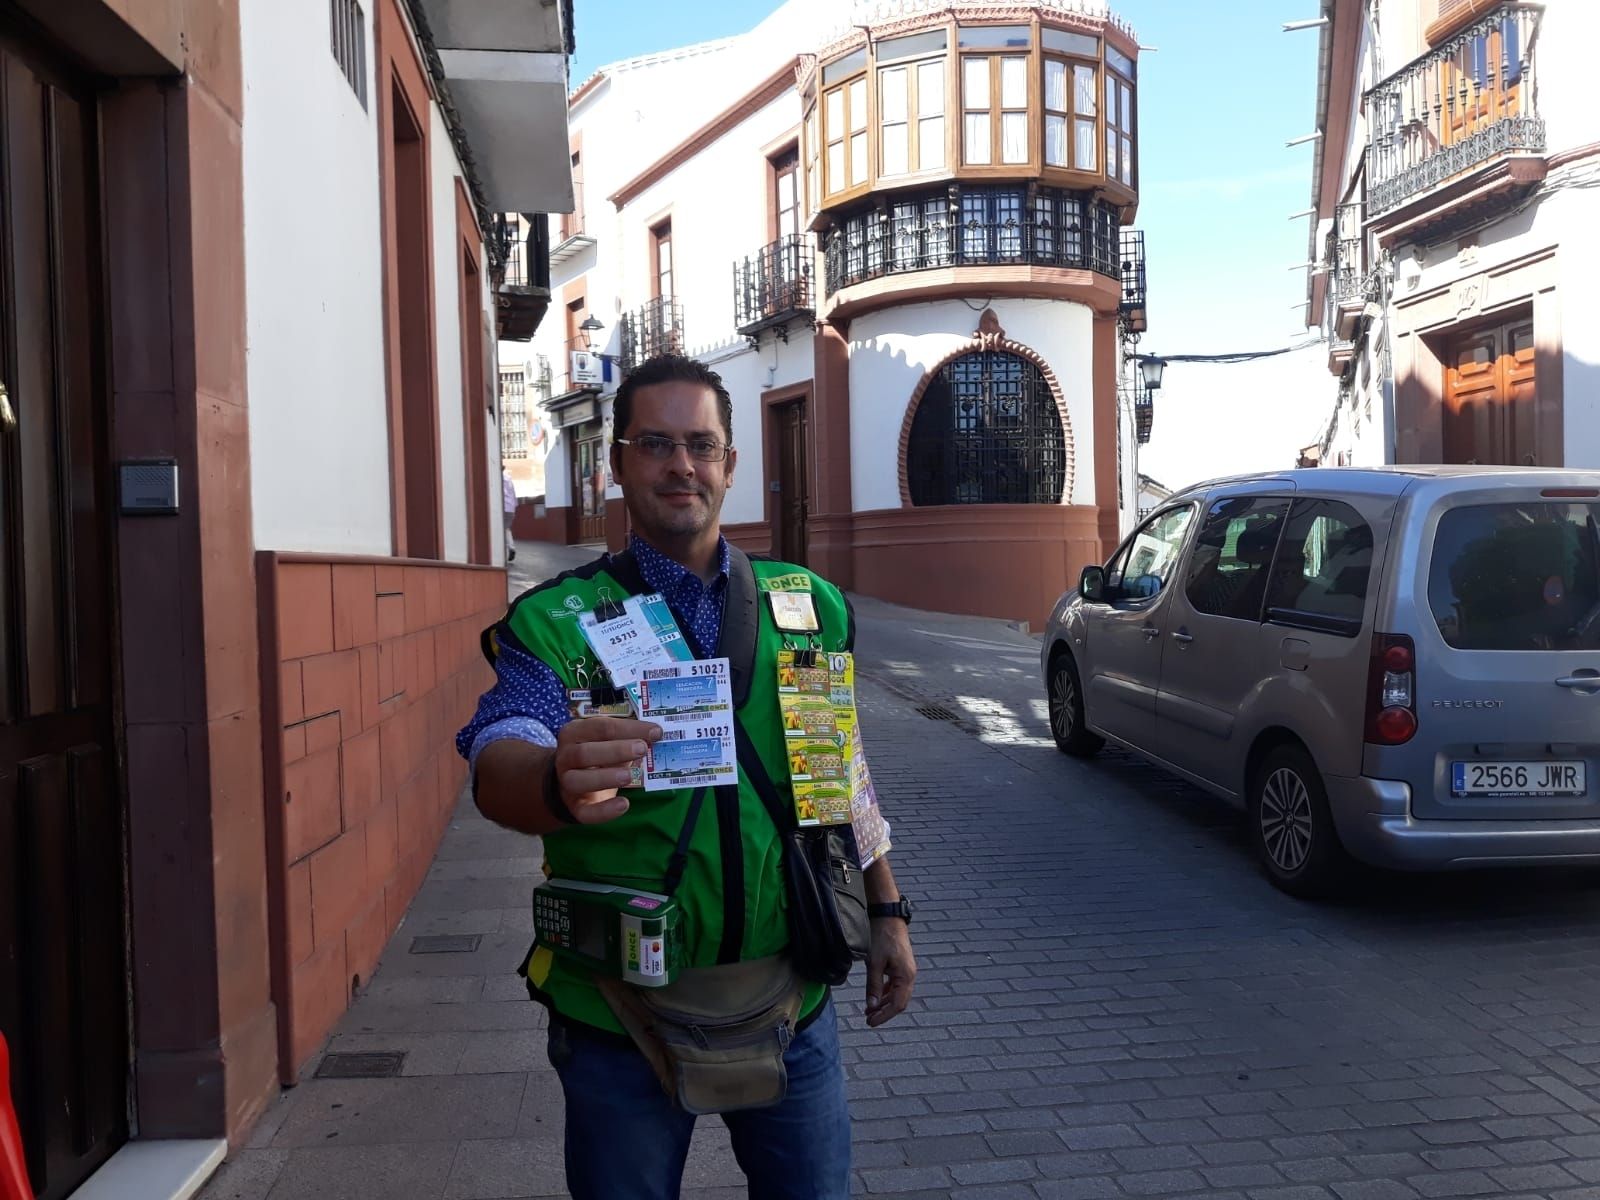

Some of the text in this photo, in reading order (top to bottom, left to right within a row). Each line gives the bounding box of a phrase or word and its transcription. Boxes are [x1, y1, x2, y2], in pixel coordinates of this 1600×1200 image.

[770, 576, 809, 590] ONCE
[609, 629, 638, 645] 25713
[691, 663, 724, 676] 51027
[1431, 700, 1504, 709] PEUGEOT
[696, 726, 729, 738] 51027
[1471, 765, 1577, 788] 2566 JWR
